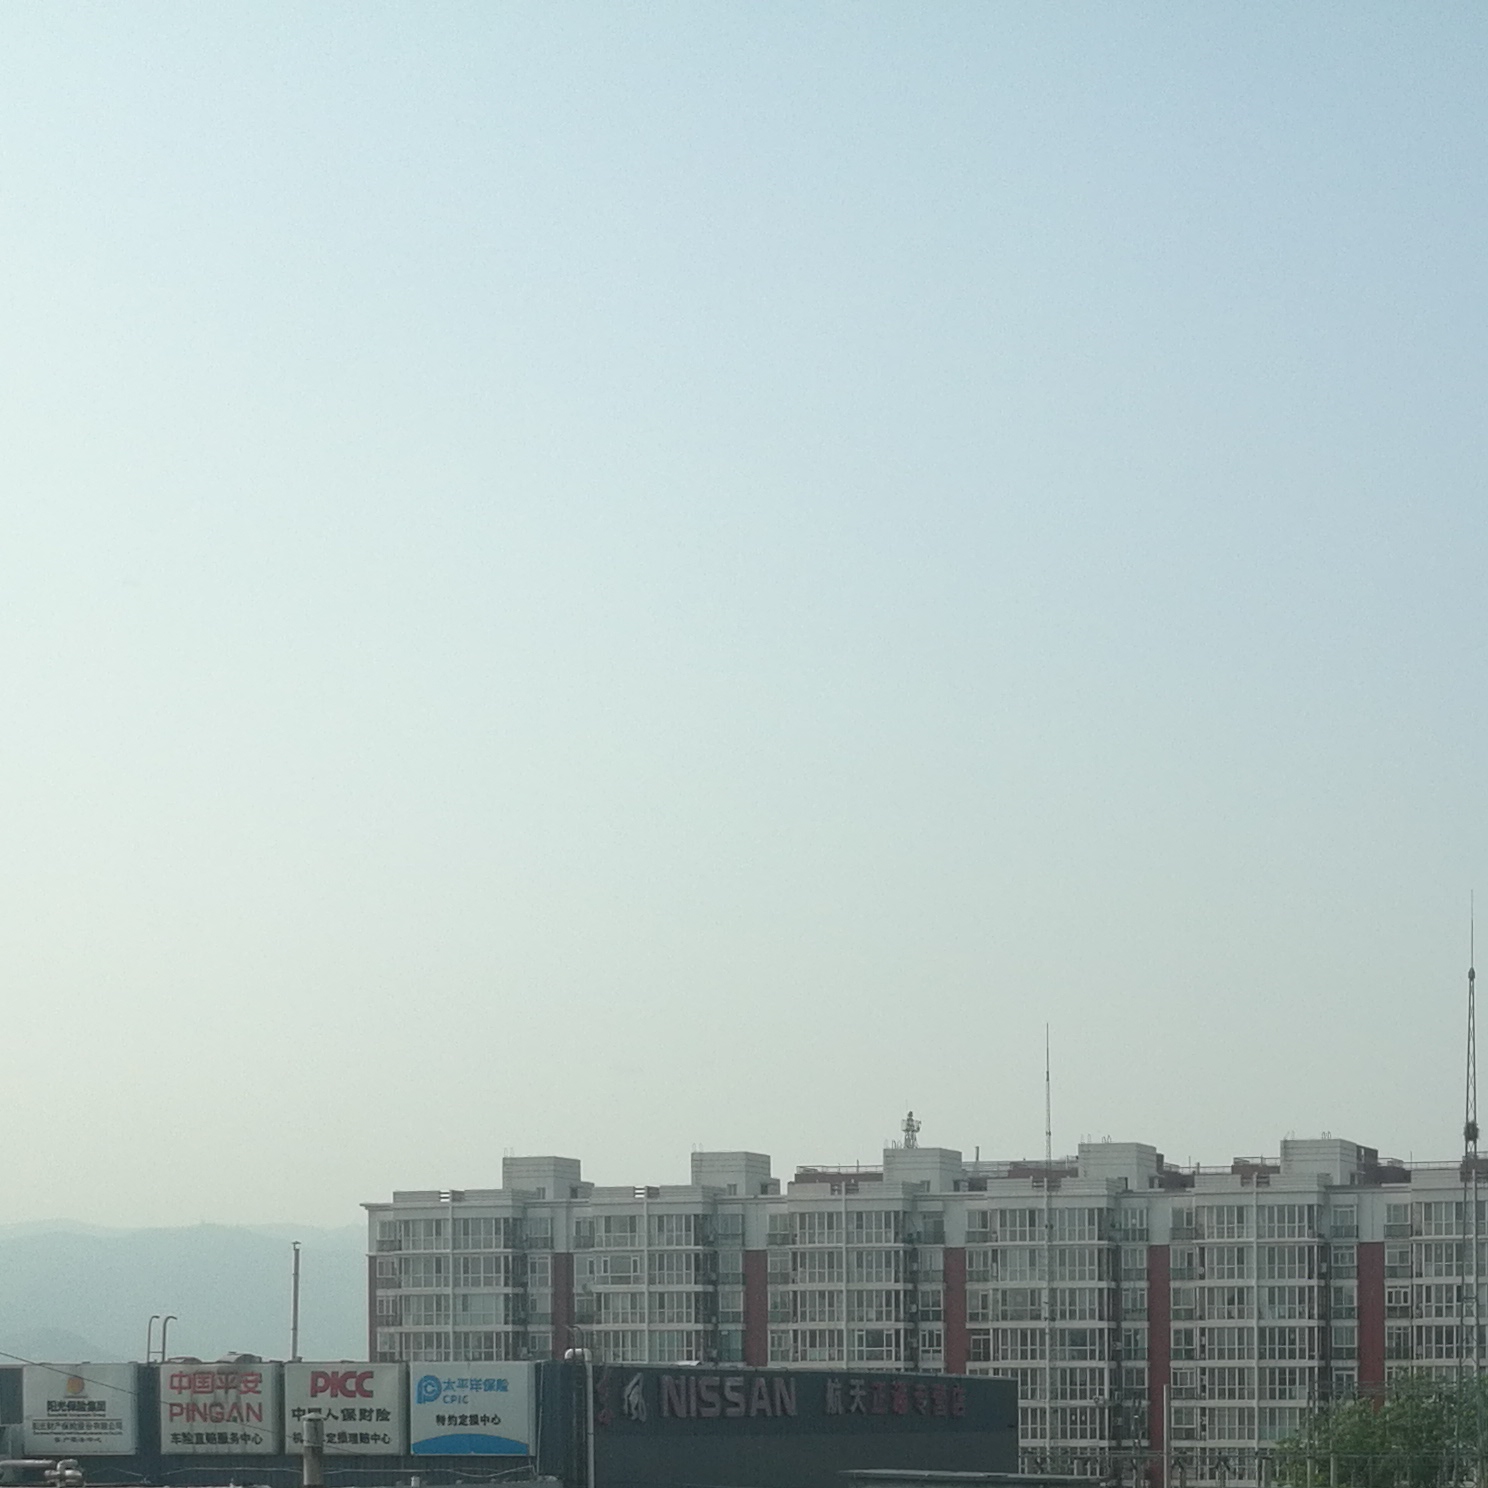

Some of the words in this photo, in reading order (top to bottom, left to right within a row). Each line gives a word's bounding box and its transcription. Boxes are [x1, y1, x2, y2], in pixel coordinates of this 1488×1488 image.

[169, 1370, 263, 1395] 中国平安
[310, 1371, 374, 1398] PICC
[443, 1378, 509, 1392] 太平洋保险
[443, 1395, 469, 1404] CPIC
[659, 1375, 798, 1418] NISSAN
[169, 1402, 263, 1423] PINGAN
[436, 1414, 501, 1427] 特约定损中心
[171, 1432, 263, 1445] 车险直赔服务中心
[293, 1432, 391, 1445] 机定损理赔中心
